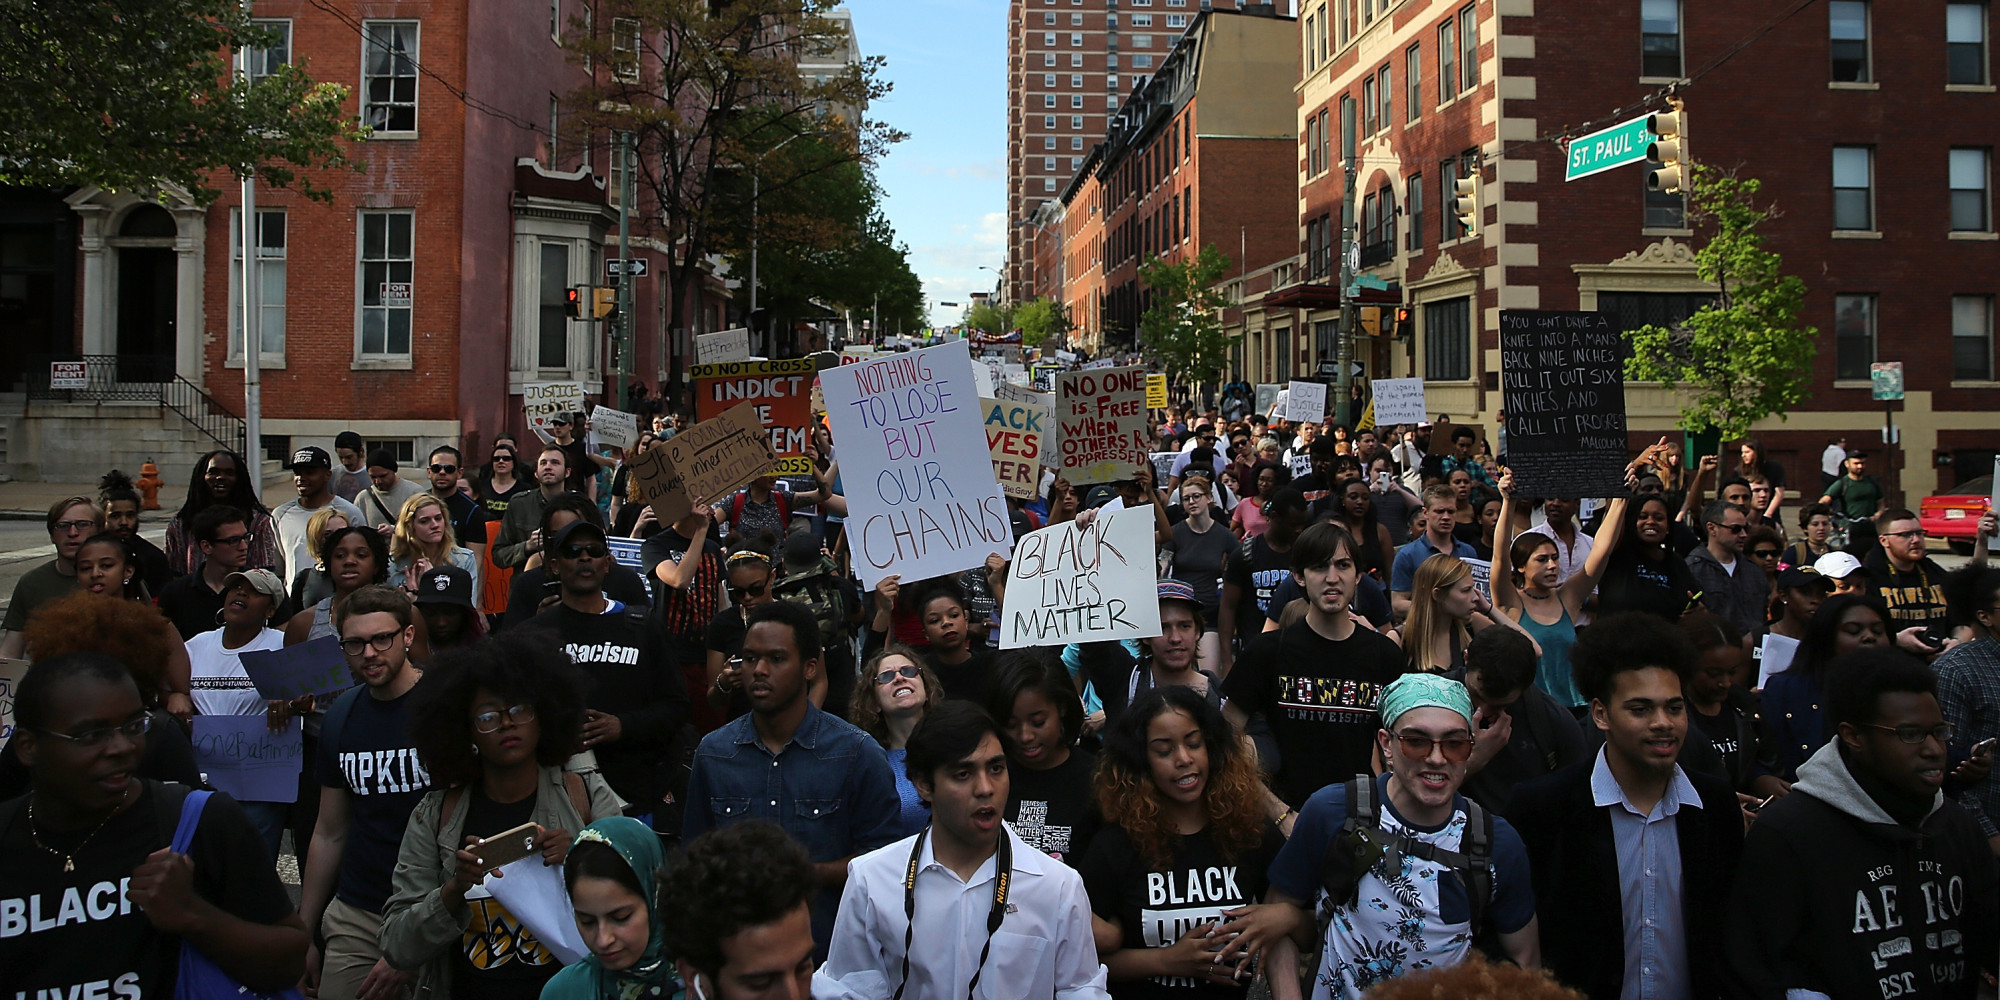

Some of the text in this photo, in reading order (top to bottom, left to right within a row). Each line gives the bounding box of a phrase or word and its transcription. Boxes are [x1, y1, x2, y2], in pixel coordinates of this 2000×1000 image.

[1572, 146, 1591, 168] ST.
[1595, 133, 1632, 161] PAUL
[1566, 316, 1591, 328] DRIVE
[1597, 316, 1608, 328] A
[1504, 332, 1534, 347] KNIFE
[1540, 331, 1566, 346] INTO
[1571, 332, 1581, 346] A
[691, 365, 714, 377] DO
[720, 361, 753, 375] NOT
[758, 360, 812, 373] CROSS
[1504, 351, 1532, 369] BACK
[1539, 350, 1568, 367] NINE
[854, 354, 932, 397] NOTHING
[1063, 370, 1145, 398] NO ONE
[1374, 382, 1388, 391] Not
[1504, 367, 1617, 389] PULL IT OUT SIX
[527, 384, 582, 399] JUSTICE
[714, 376, 804, 401] INDICT
[1295, 384, 1321, 398] GOT
[1568, 391, 1598, 410] AND
[850, 380, 957, 428] TO LOSE
[1071, 399, 1088, 415] is
[1097, 395, 1140, 419] FREE
[1290, 400, 1323, 412] JUSTICE
[985, 404, 1044, 432] ACK
[1062, 417, 1118, 438] WHEN
[1508, 417, 1547, 437] CALL
[1554, 417, 1567, 434] IT
[680, 416, 738, 450] YOUNG
[883, 420, 936, 460] BUT
[985, 428, 1038, 459] VES
[1062, 430, 1146, 455] OTHERS R
[1619, 438, 1627, 449] X
[649, 472, 686, 500] always
[691, 440, 733, 477] inherit
[736, 431, 760, 448] the
[1064, 449, 1146, 468] OPPRESSED
[877, 462, 954, 505] OUR
[864, 496, 1007, 569] CHAINS
[1016, 515, 1128, 579] BLACK
[1041, 571, 1102, 608] LIVES
[1013, 599, 1139, 643] MATTER
[565, 641, 639, 665] Racism
[1018, 814, 1040, 822] BLACK
[907, 860, 917, 889] Nikon
[1867, 860, 1942, 882] REG TMK
[997, 872, 1008, 904] Nikon
[1147, 866, 1243, 906] BLACK
[1879, 971, 1917, 1000] EST
